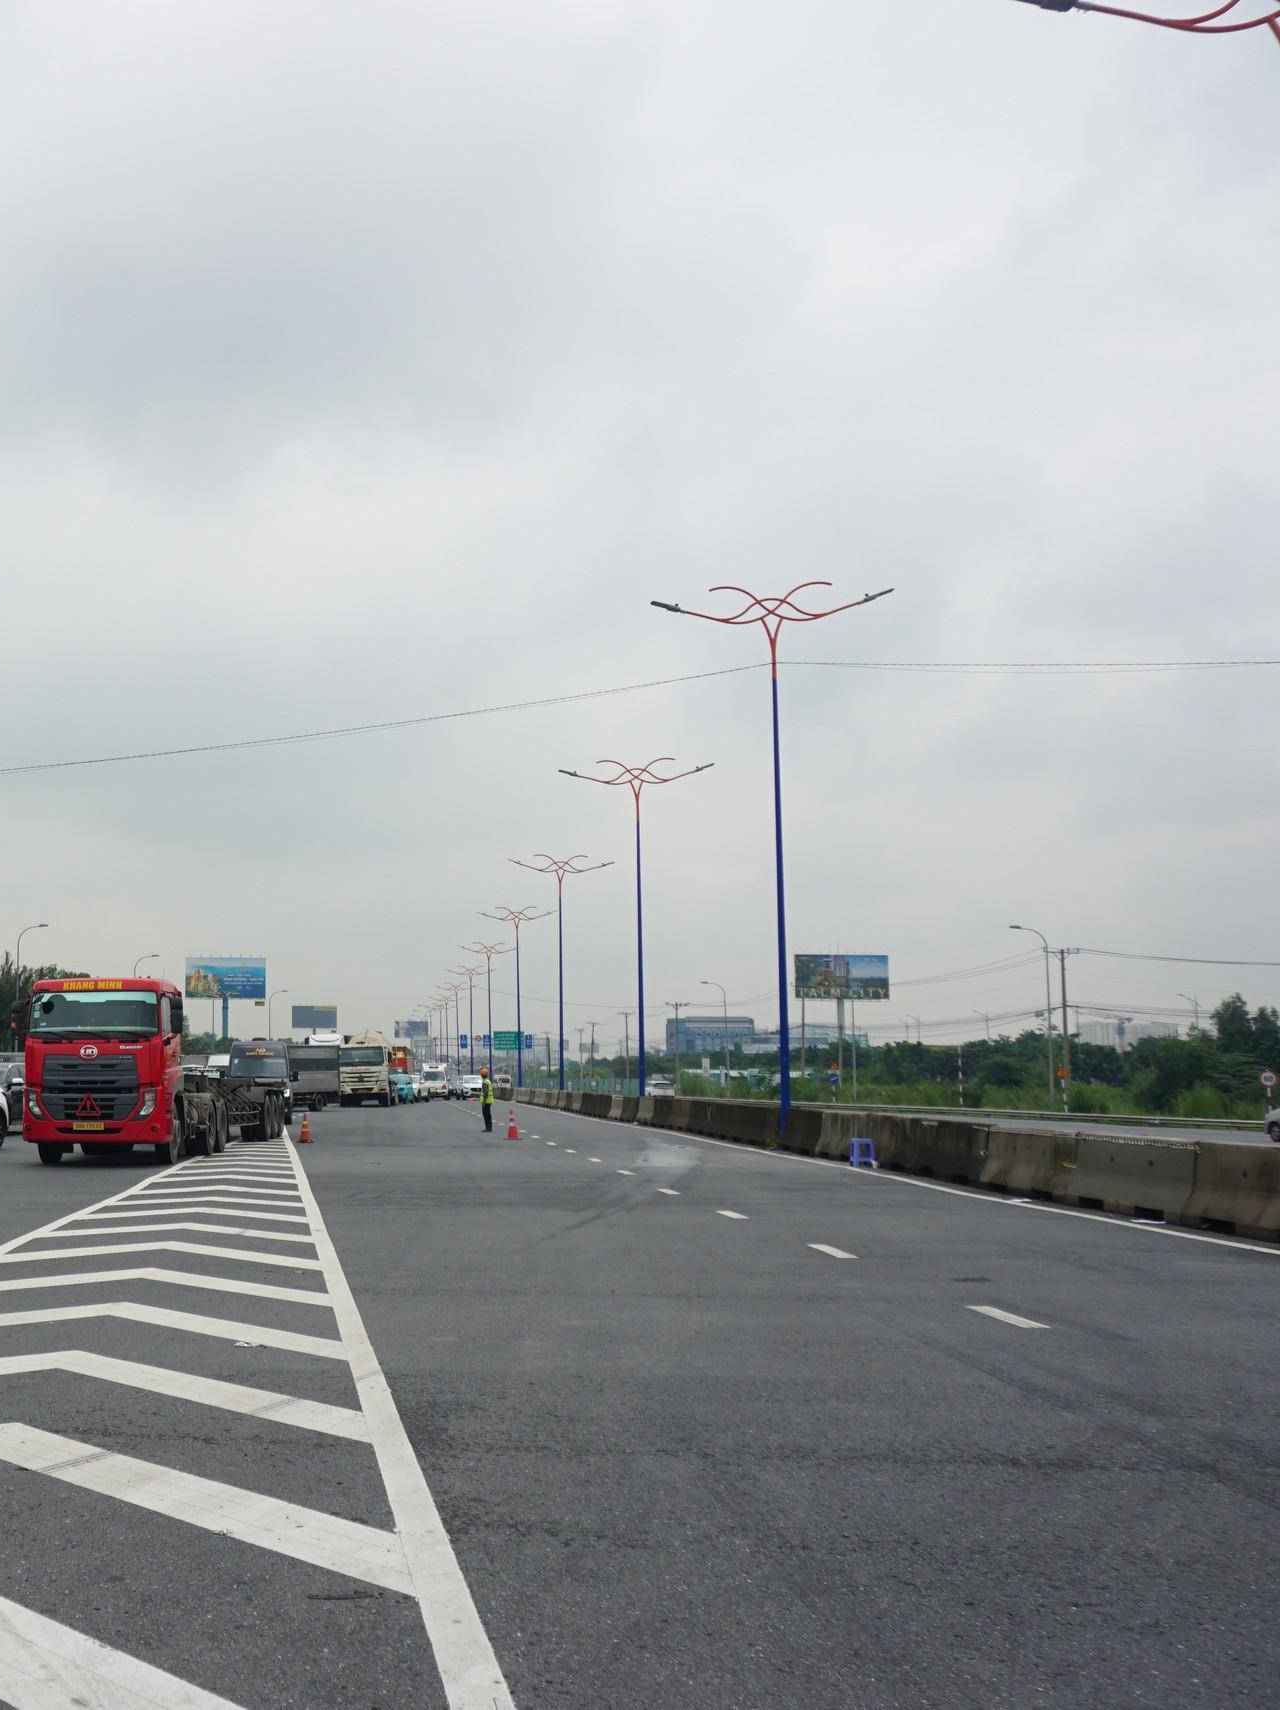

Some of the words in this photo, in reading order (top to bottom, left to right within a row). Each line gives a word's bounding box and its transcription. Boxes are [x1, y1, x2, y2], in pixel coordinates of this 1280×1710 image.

[63, 981, 95, 991] KHANG
[97, 980, 124, 990] MINH
[848, 985, 886, 998] CITY
